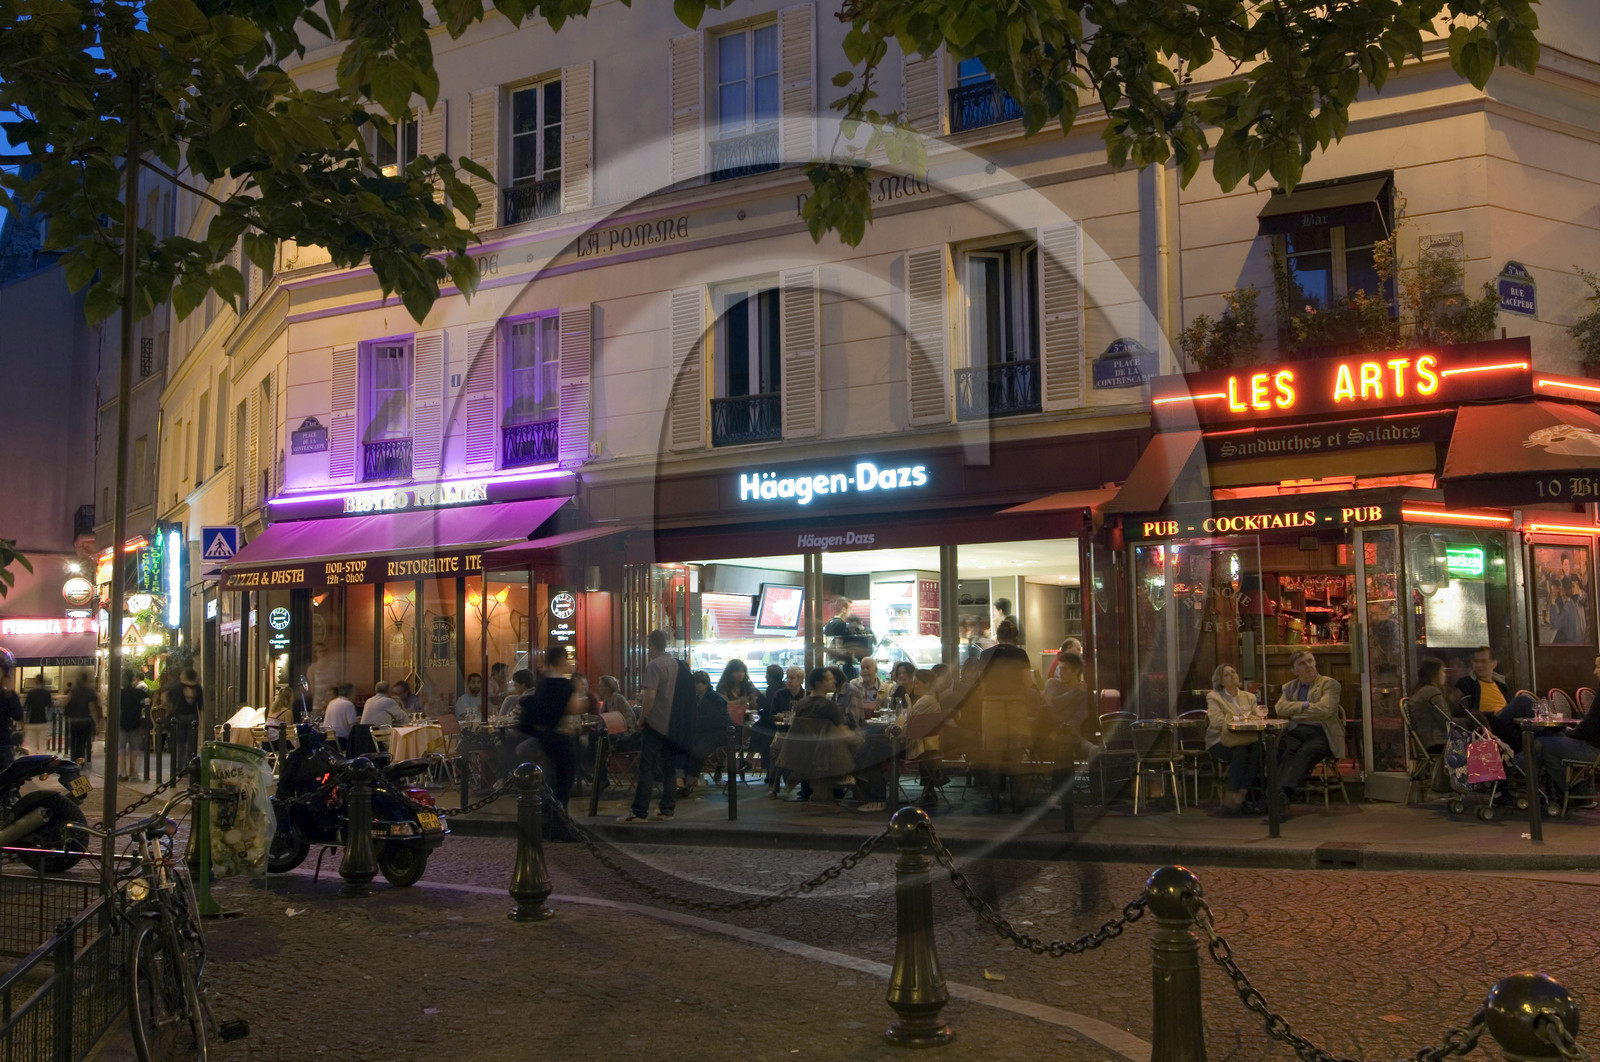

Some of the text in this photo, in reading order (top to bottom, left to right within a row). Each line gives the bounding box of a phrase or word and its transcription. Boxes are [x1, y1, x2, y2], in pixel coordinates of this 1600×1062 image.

[1302, 213, 1329, 226] Bar
[1510, 287, 1525, 297] RUE
[1113, 358, 1141, 368] PLACE
[1114, 367, 1139, 377] DE LA
[1228, 354, 1439, 413] LES ARTS
[1220, 425, 1421, 458] Sandwiches et Salades
[740, 462, 927, 505] Häagen-Dazs
[1535, 479, 1562, 497] 10
[342, 492, 409, 513] BISTRO
[1143, 520, 1179, 536] PUB
[1202, 511, 1316, 533] COCKTAILS
[1341, 505, 1383, 523] PUB
[797, 531, 875, 549] Häagen-Dazs
[142, 552, 150, 589] CHALET
[325, 560, 367, 574] NON-STOP
[387, 556, 460, 577] RISTORANTE
[226, 569, 305, 586] PIZZA & PASTA
[326, 575, 339, 584] 12h
[1183, 586, 1252, 609] BLANCHE
[1193, 616, 1246, 633] LEFFE
[39, 657, 51, 666] LE
[429, 658, 450, 668] PASTA
